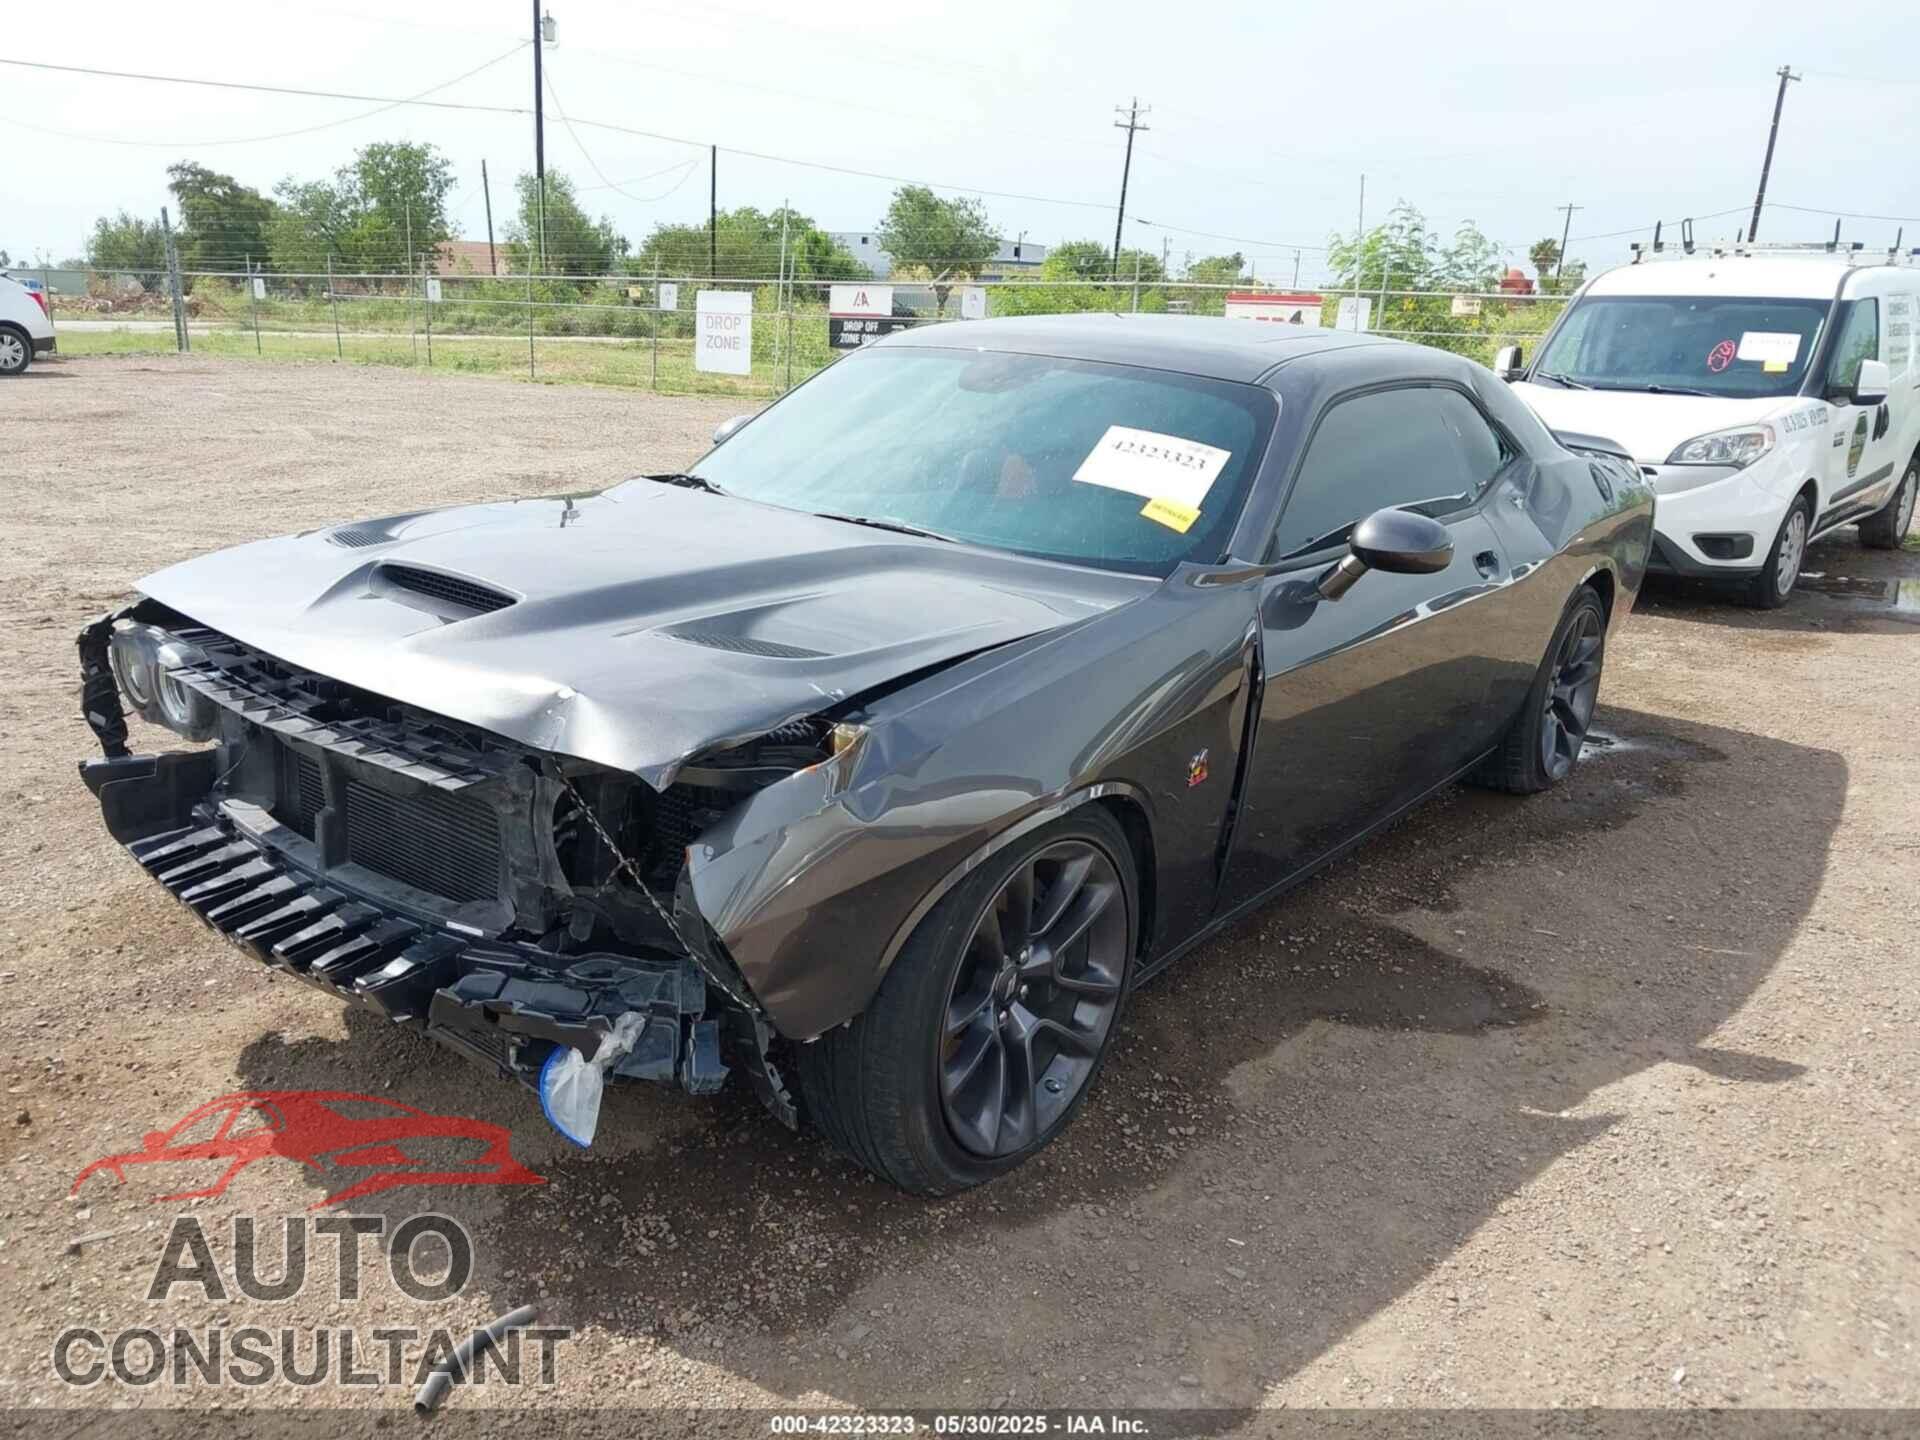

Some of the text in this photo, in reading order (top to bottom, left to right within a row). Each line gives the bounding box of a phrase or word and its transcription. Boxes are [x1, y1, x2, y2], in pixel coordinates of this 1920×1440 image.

[705, 315, 742, 331] DROP
[843, 321, 879, 333] DROP OFF
[705, 335, 742, 351] ZONE
[840, 333, 861, 344] ZONE
[1112, 440, 1205, 469] 42323323
